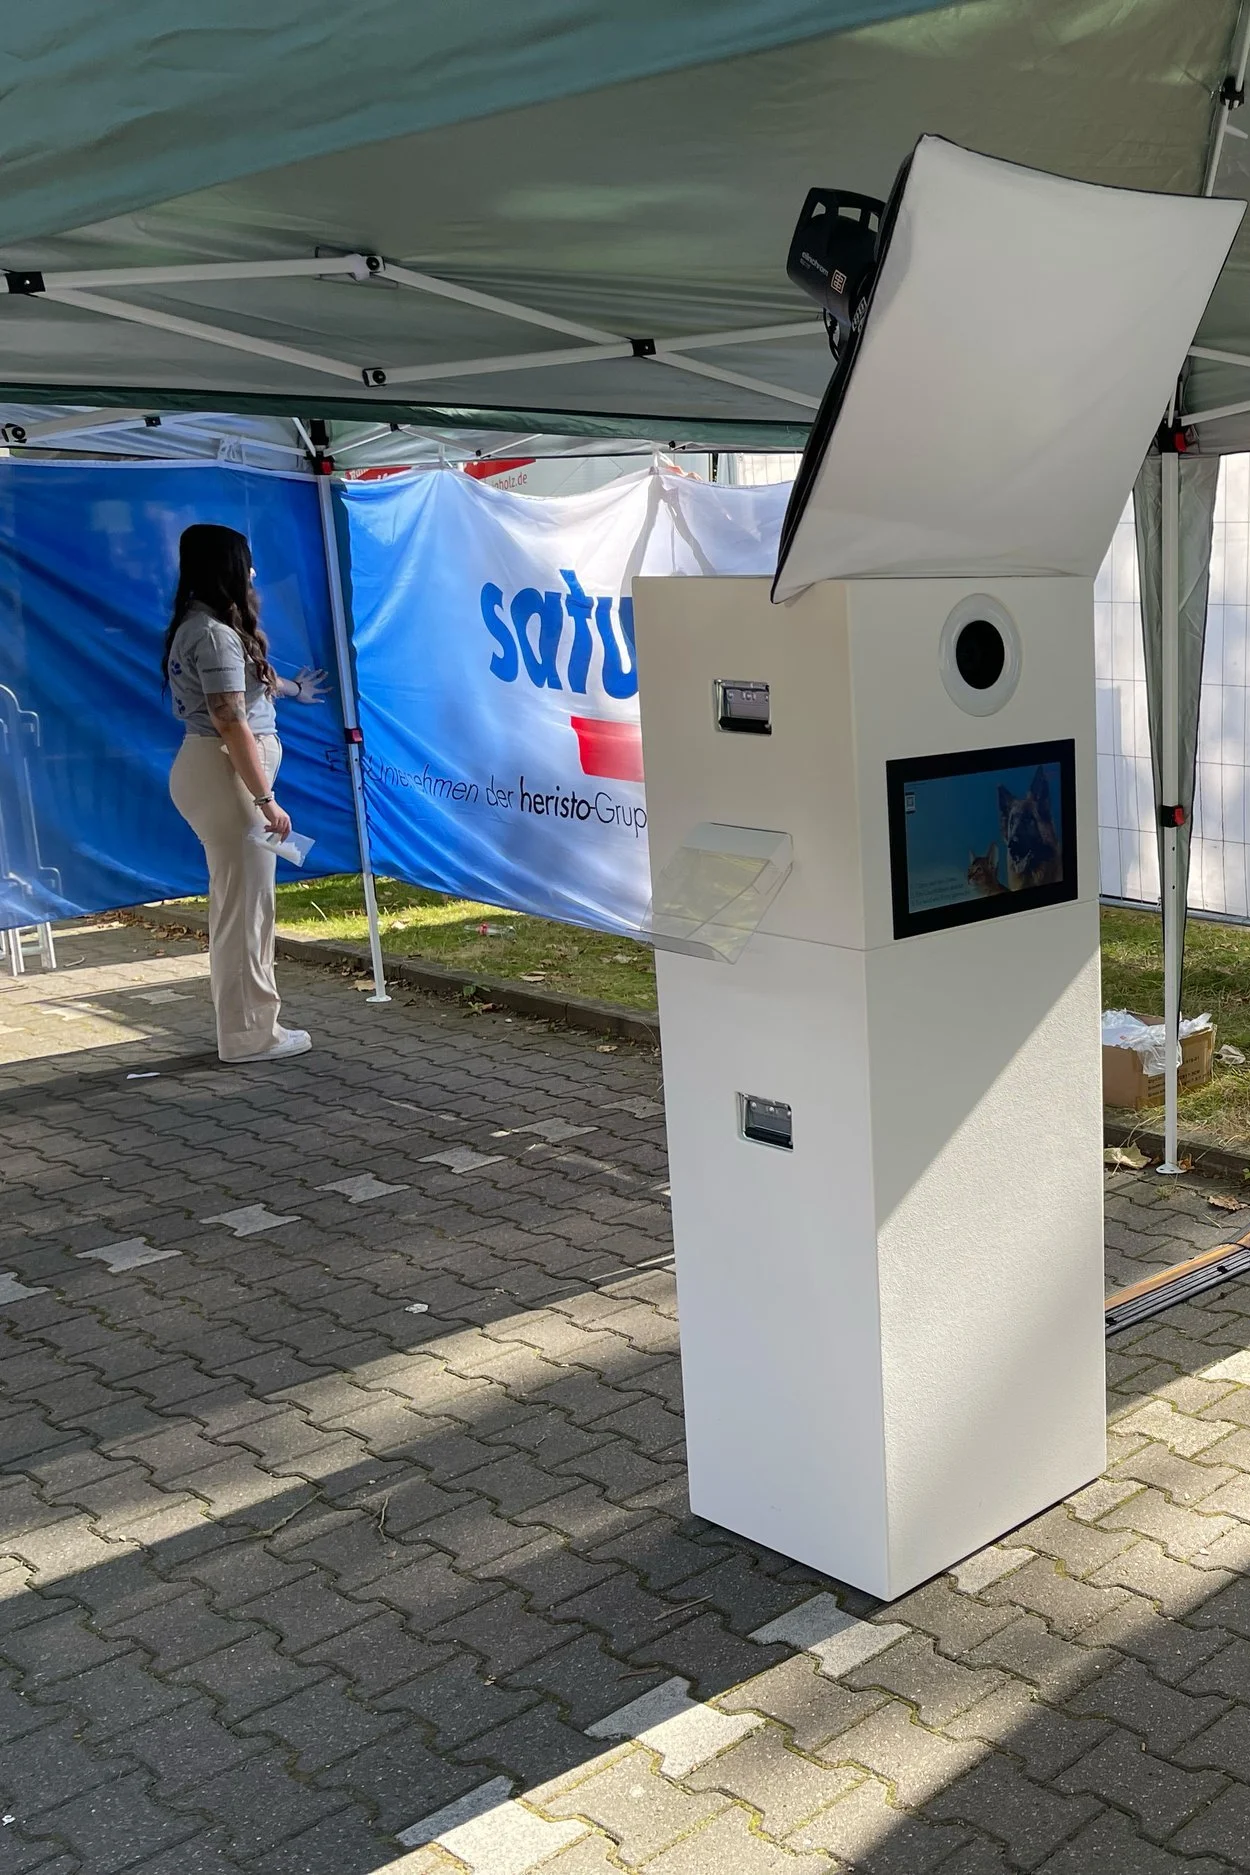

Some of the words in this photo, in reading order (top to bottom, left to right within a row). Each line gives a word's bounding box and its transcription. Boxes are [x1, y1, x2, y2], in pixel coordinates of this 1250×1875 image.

[480, 569, 639, 699] satu
[367, 755, 479, 803] Unteehmen
[486, 775, 514, 809] der
[520, 776, 648, 838] heristo-Grup
